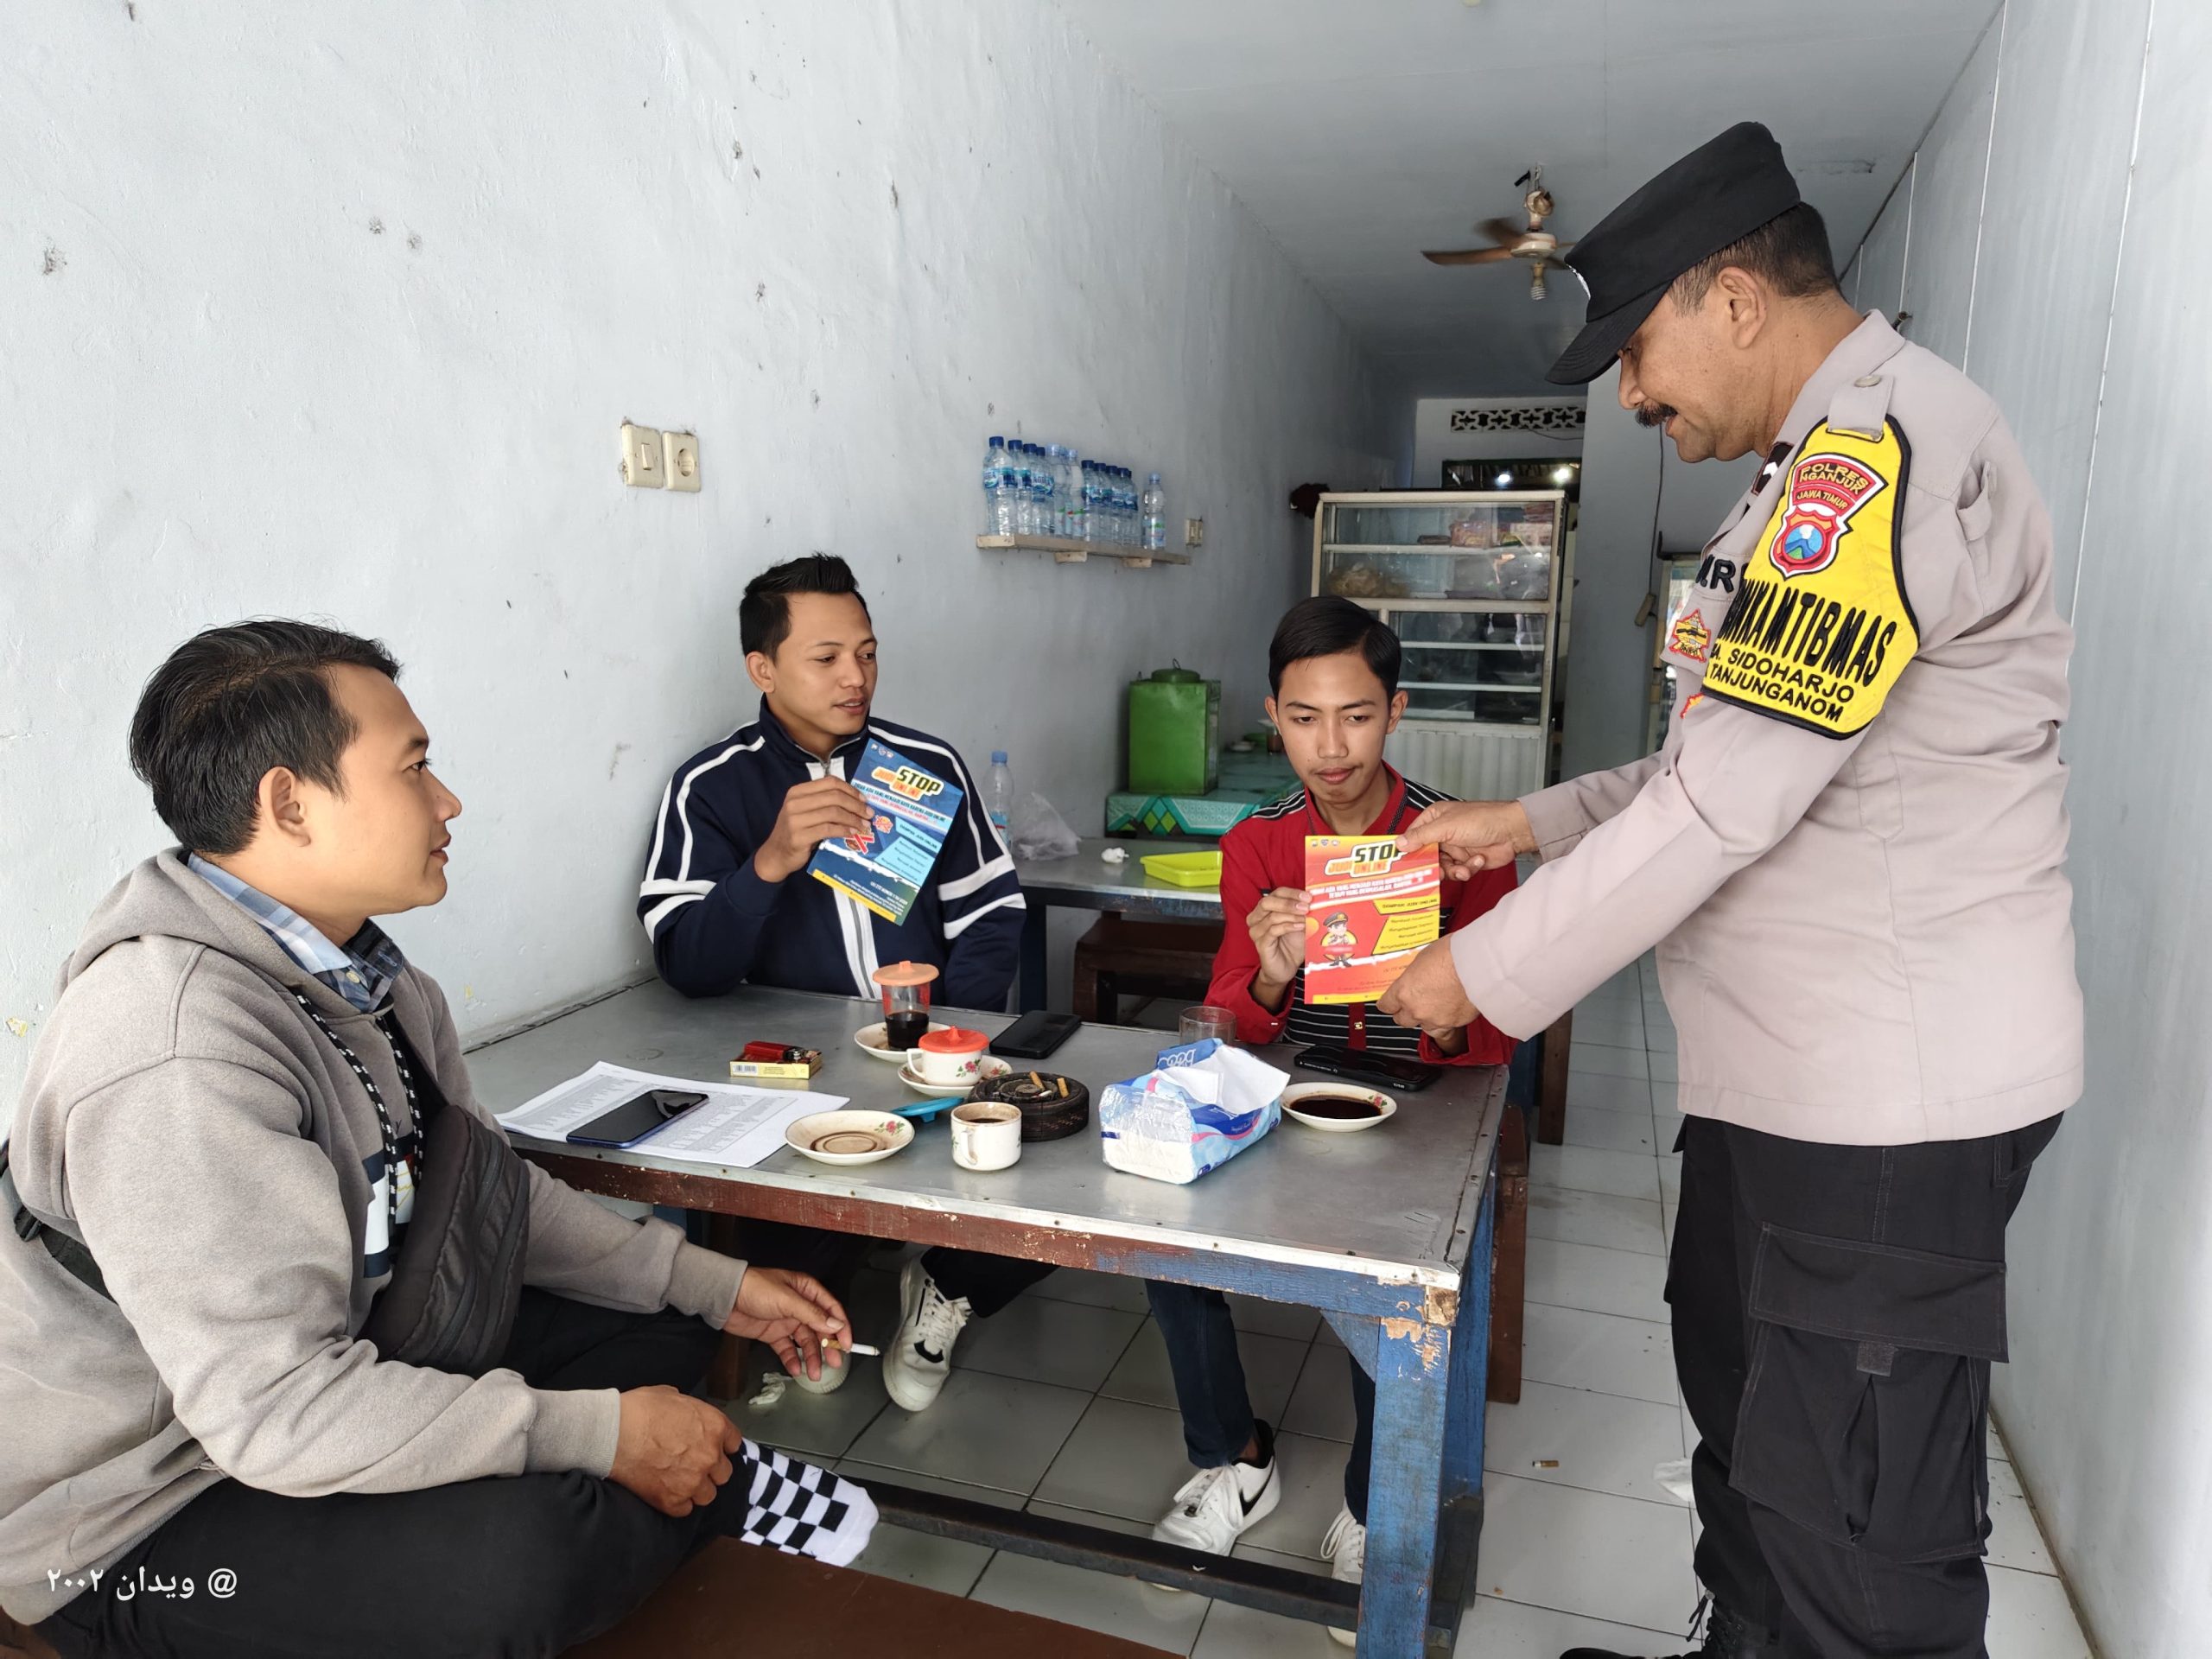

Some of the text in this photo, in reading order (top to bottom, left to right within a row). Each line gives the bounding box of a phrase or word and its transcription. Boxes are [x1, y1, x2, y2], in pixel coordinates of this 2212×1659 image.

[1799, 472, 1861, 495] NGANJUK
[1800, 463, 1869, 489] POLRES
[1797, 489, 1848, 510] JAWA TIMUR
[1728, 648, 1854, 703] SIDOHARJO
[1709, 664, 1845, 722] TANJUNGANOM
[897, 769, 941, 795] STOP
